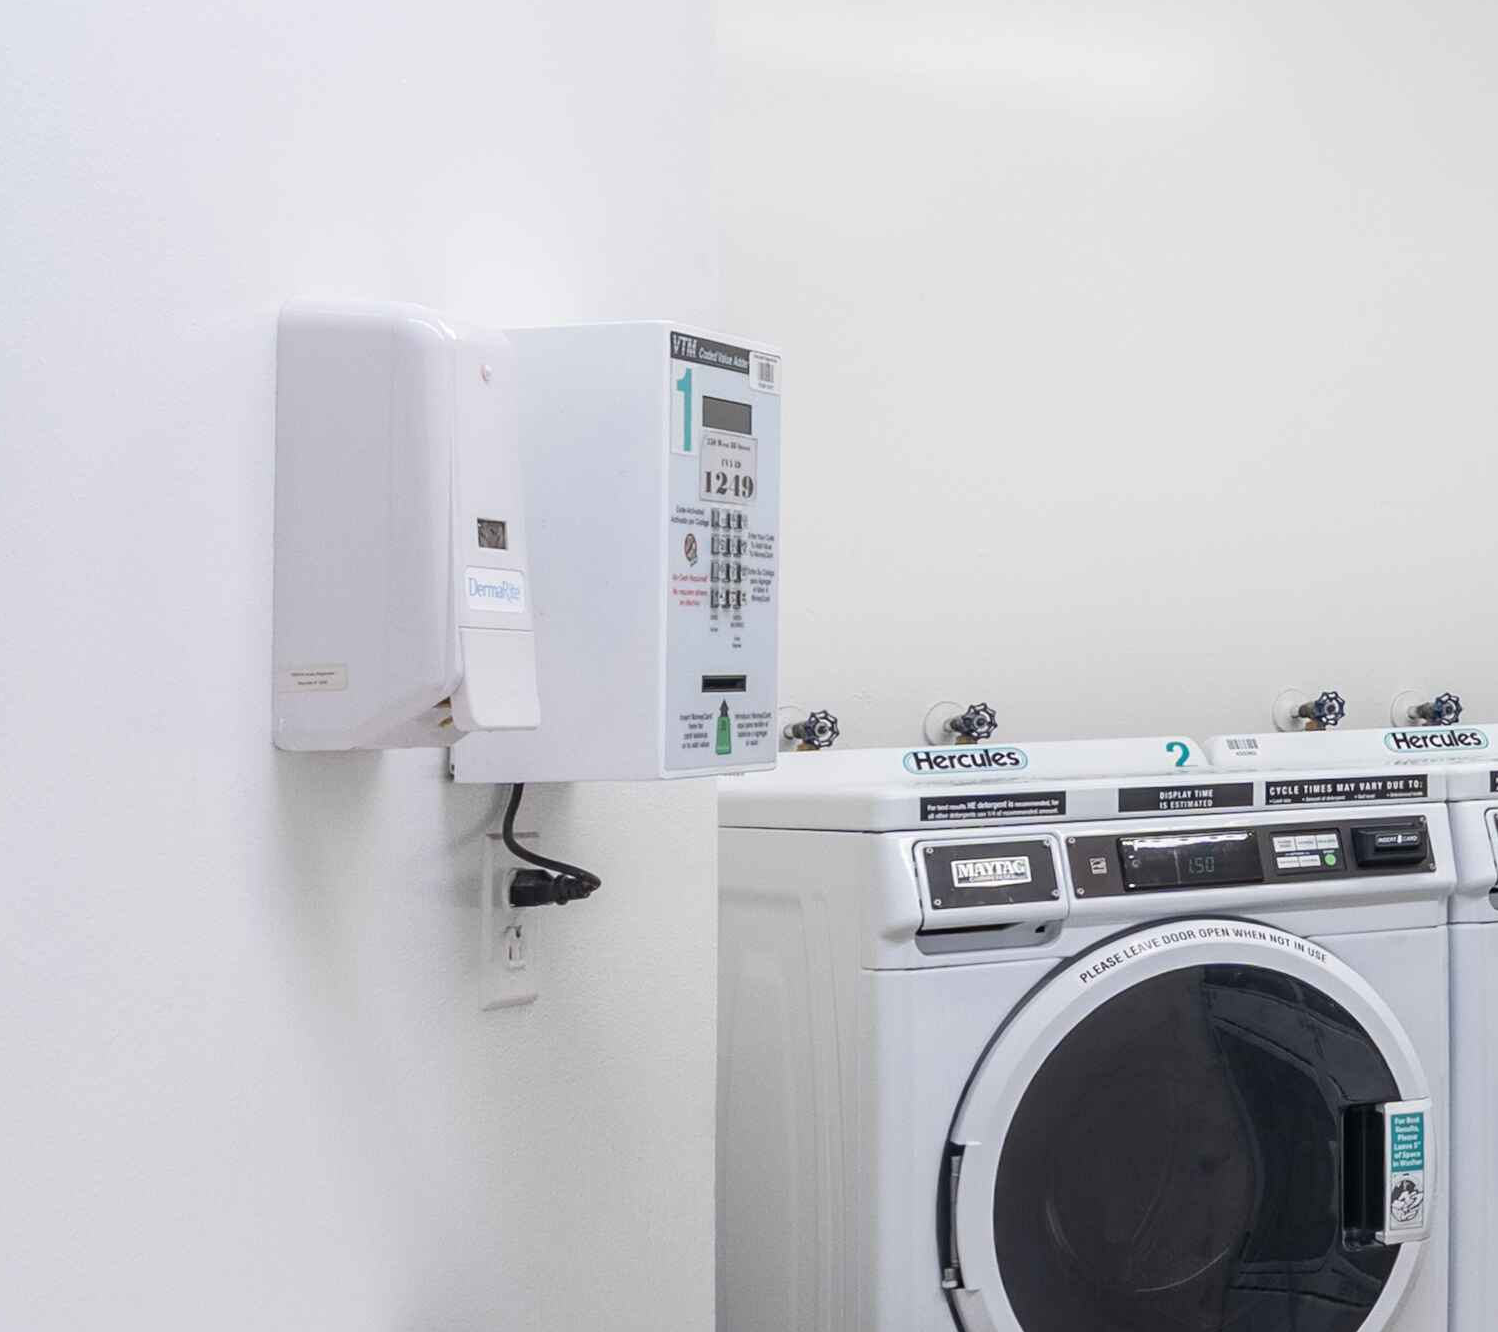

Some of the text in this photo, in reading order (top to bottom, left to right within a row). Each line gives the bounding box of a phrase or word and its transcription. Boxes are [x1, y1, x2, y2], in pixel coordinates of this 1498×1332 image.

[672, 335, 697, 359] VTM
[677, 367, 693, 452] 1
[704, 470, 754, 498] 1249
[468, 577, 520, 603] DermaRite
[1392, 730, 1482, 750] Hercules
[912, 750, 1021, 770] Hercules
[1165, 741, 1191, 768] 2
[1269, 784, 1299, 796] CYCLE
[1303, 783, 1332, 794] TIMES
[1336, 782, 1356, 793] MAY
[1360, 781, 1384, 791] VARY
[1387, 780, 1405, 790] DUE
[957, 859, 1026, 879] MAYTAG
[1079, 927, 1327, 984] PLEASE LEAVE DOOR OPEN WHEN NOT IN USE
